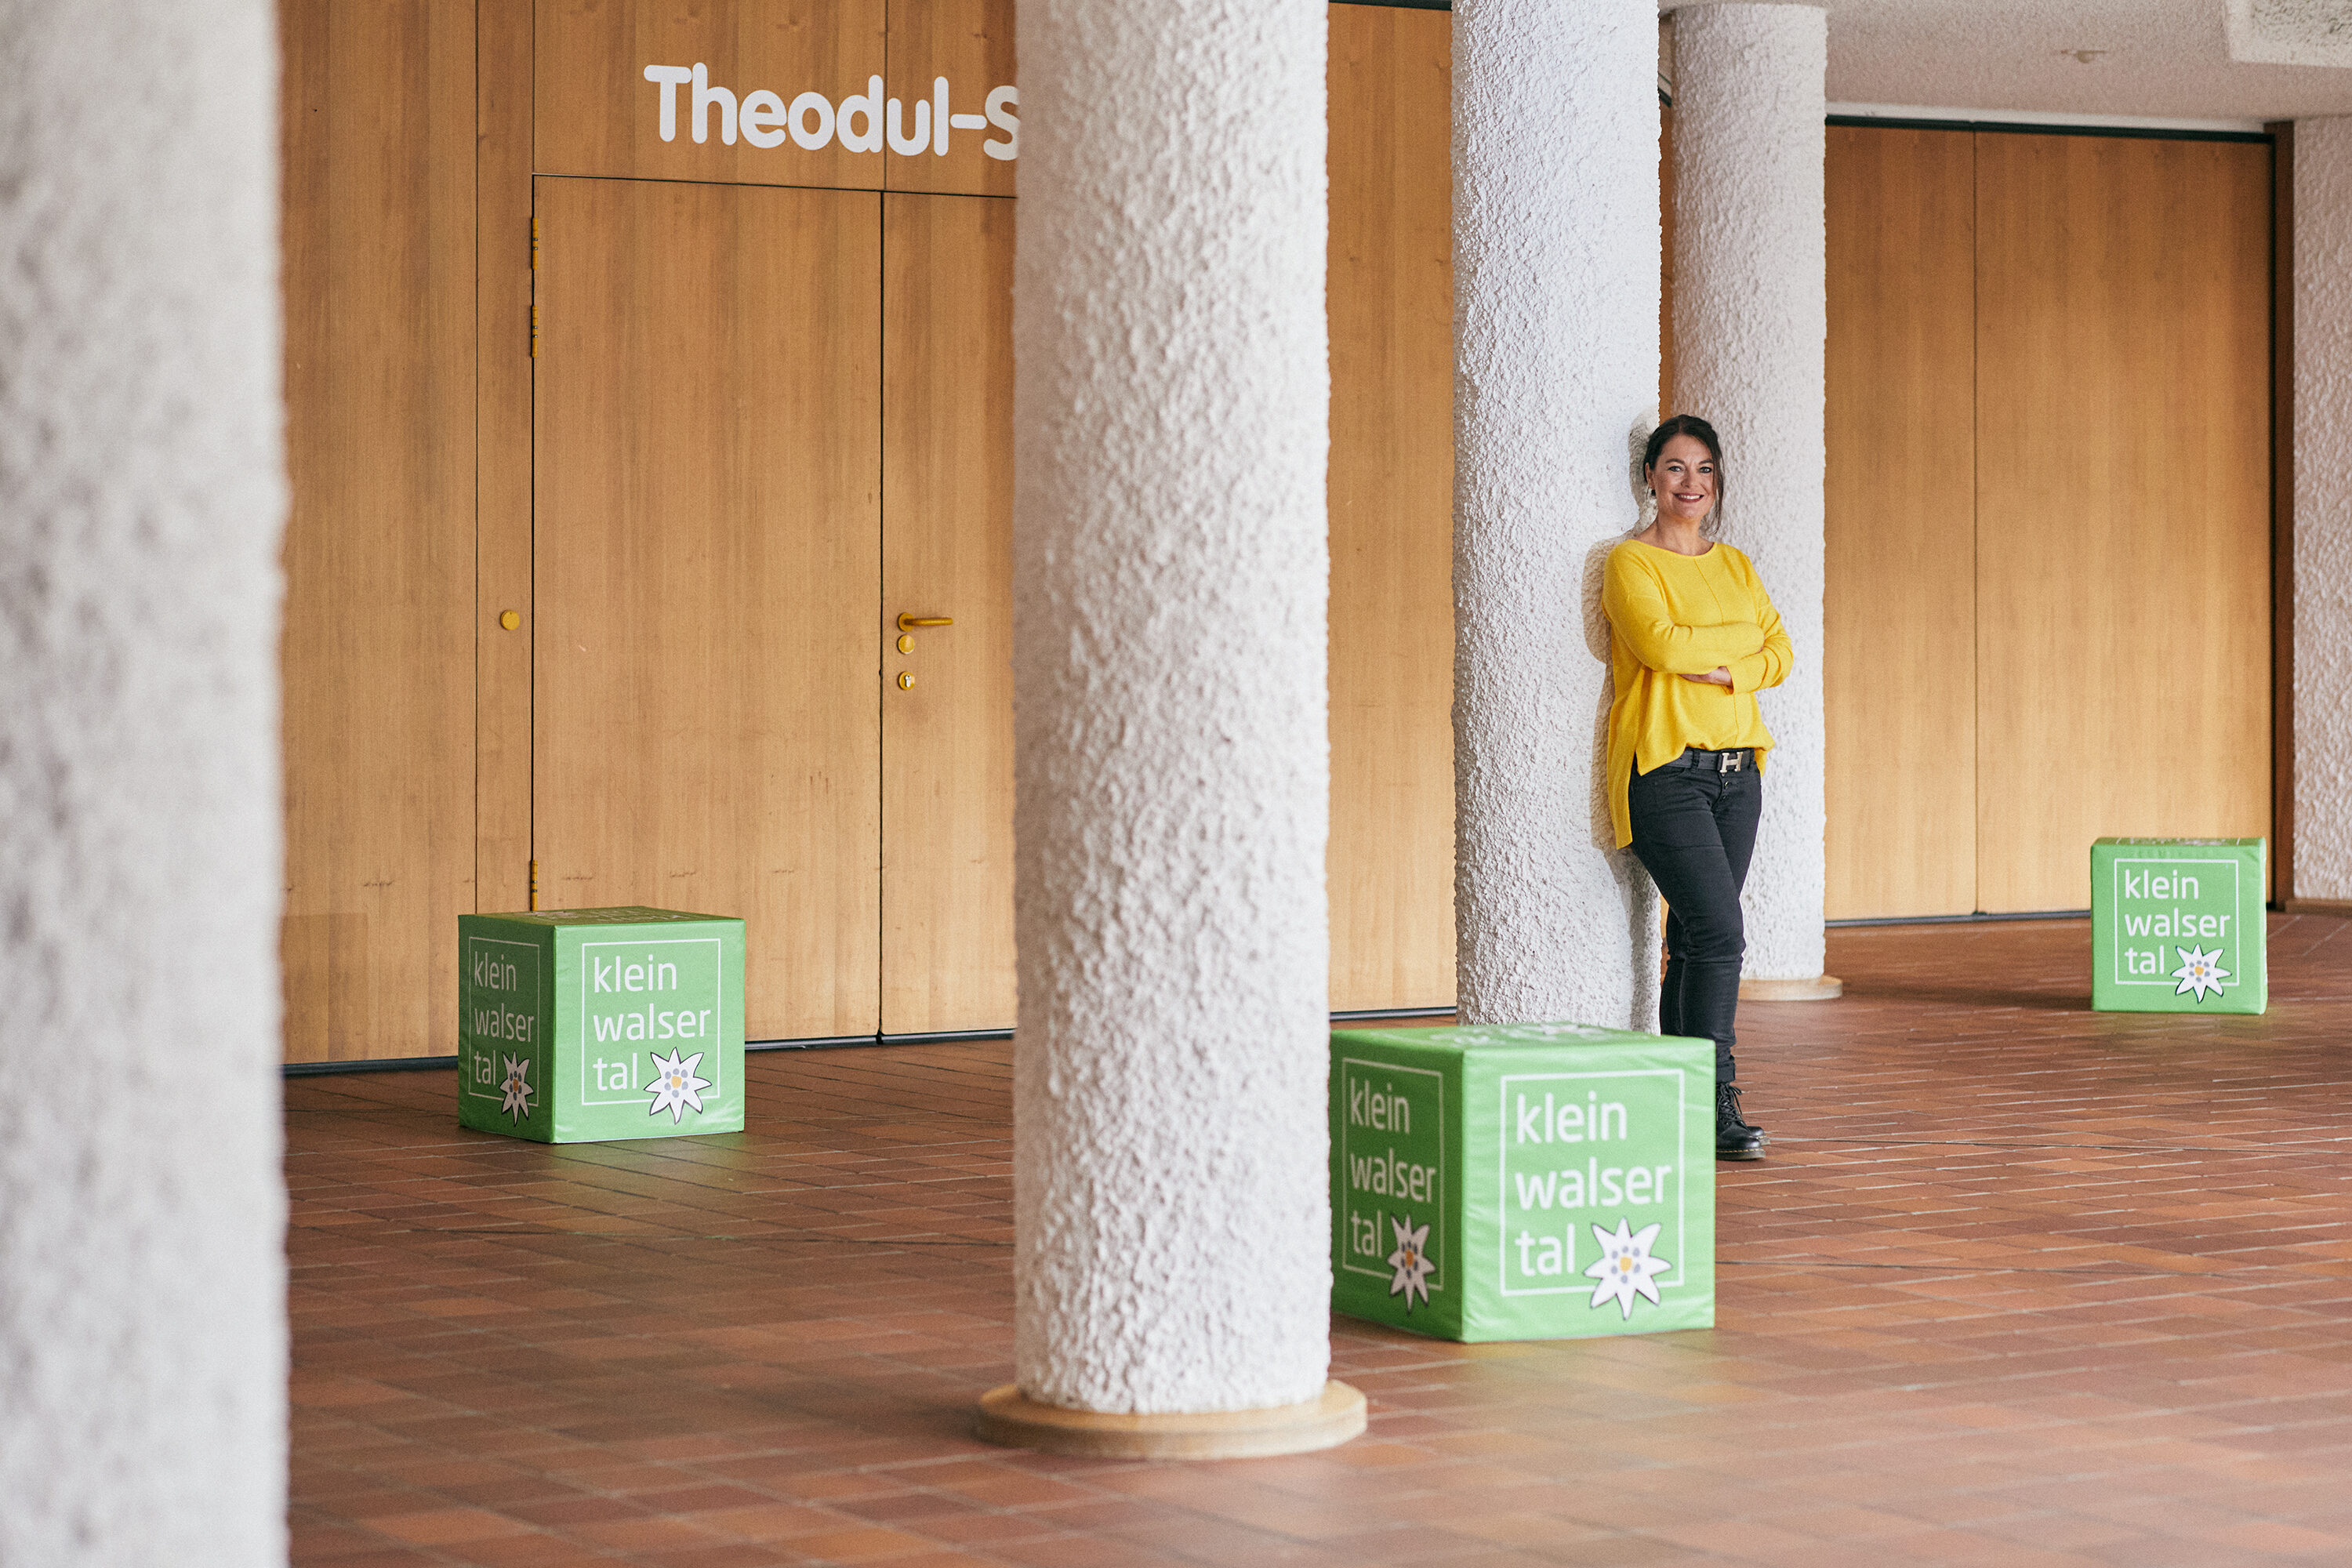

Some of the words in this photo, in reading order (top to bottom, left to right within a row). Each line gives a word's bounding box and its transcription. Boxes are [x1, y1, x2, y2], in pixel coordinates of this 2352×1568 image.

[2125, 869, 2199, 899] klein
[2124, 907, 2230, 938] walser
[474, 951, 516, 992] klein
[594, 954, 677, 993] klein
[2124, 945, 2165, 975] tal
[474, 1003, 535, 1043] walser
[593, 1004, 711, 1042] walser
[474, 1049, 496, 1086] tal
[592, 1052, 638, 1091] tal
[1350, 1077, 1410, 1134] klein
[1516, 1090, 1628, 1144] klein
[1349, 1148, 1436, 1203] walser
[1514, 1156, 1672, 1210] walser
[1351, 1210, 1382, 1258] tal
[1514, 1222, 1575, 1277] tal
